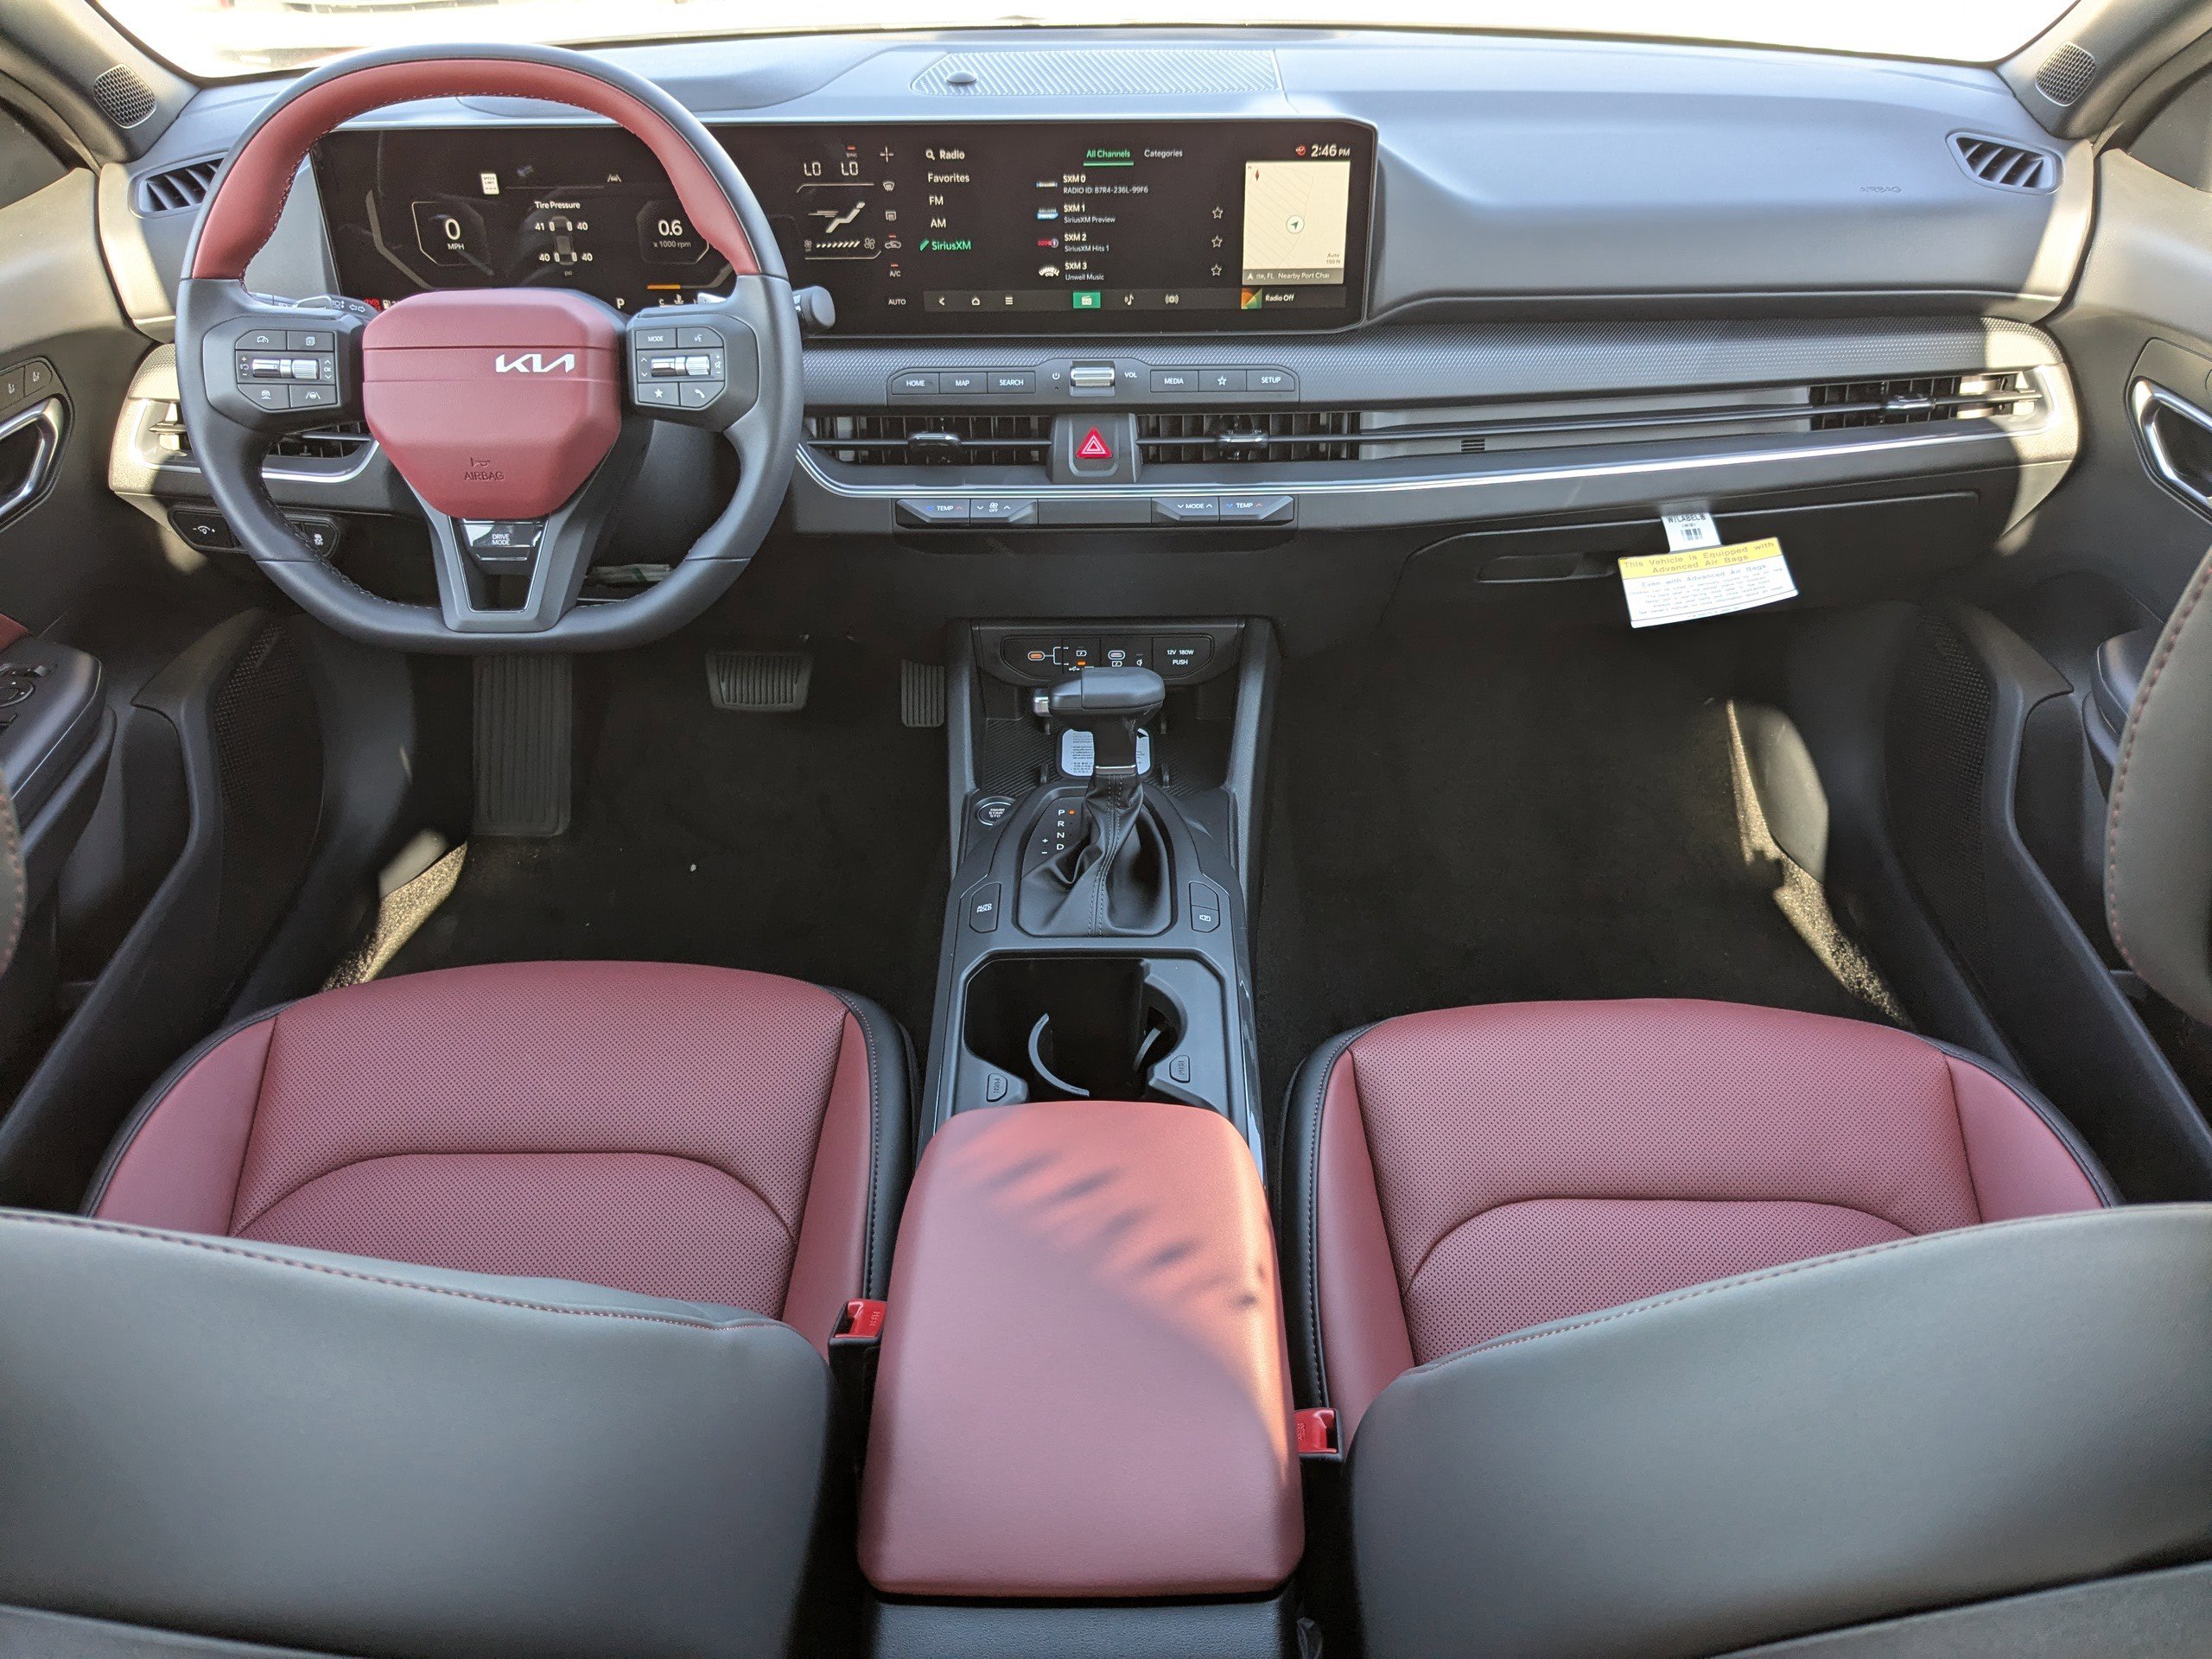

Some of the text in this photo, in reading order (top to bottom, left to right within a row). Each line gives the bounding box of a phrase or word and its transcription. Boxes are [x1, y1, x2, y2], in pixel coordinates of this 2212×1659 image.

[939, 149, 965, 159] Radio
[1086, 149, 1131, 158] All Channels
[1144, 149, 1182, 159] Categories
[1311, 144, 1351, 157] 2:46 PM
[928, 172, 970, 183] Favorites
[1063, 175, 1086, 183] SXM 0
[929, 195, 944, 206] FM
[1064, 204, 1081, 213] SXM
[1081, 204, 1085, 212] 1
[658, 219, 683, 236] 0.6
[930, 218, 947, 228] AM
[445, 218, 461, 240] 0
[931, 241, 972, 251] SiriusXM
[539, 253, 550, 261] 40
[582, 253, 593, 261] 40
[616, 297, 625, 309] P
[464, 471, 504, 481] AIRBAG
[1649, 556, 1683, 565] Vehicle
[1703, 547, 1748, 559] Equipped
[1754, 541, 1774, 550] with
[1653, 562, 1699, 573] Advanced
[1724, 555, 1748, 563] Bags
[1687, 572, 1725, 582] Advanced
